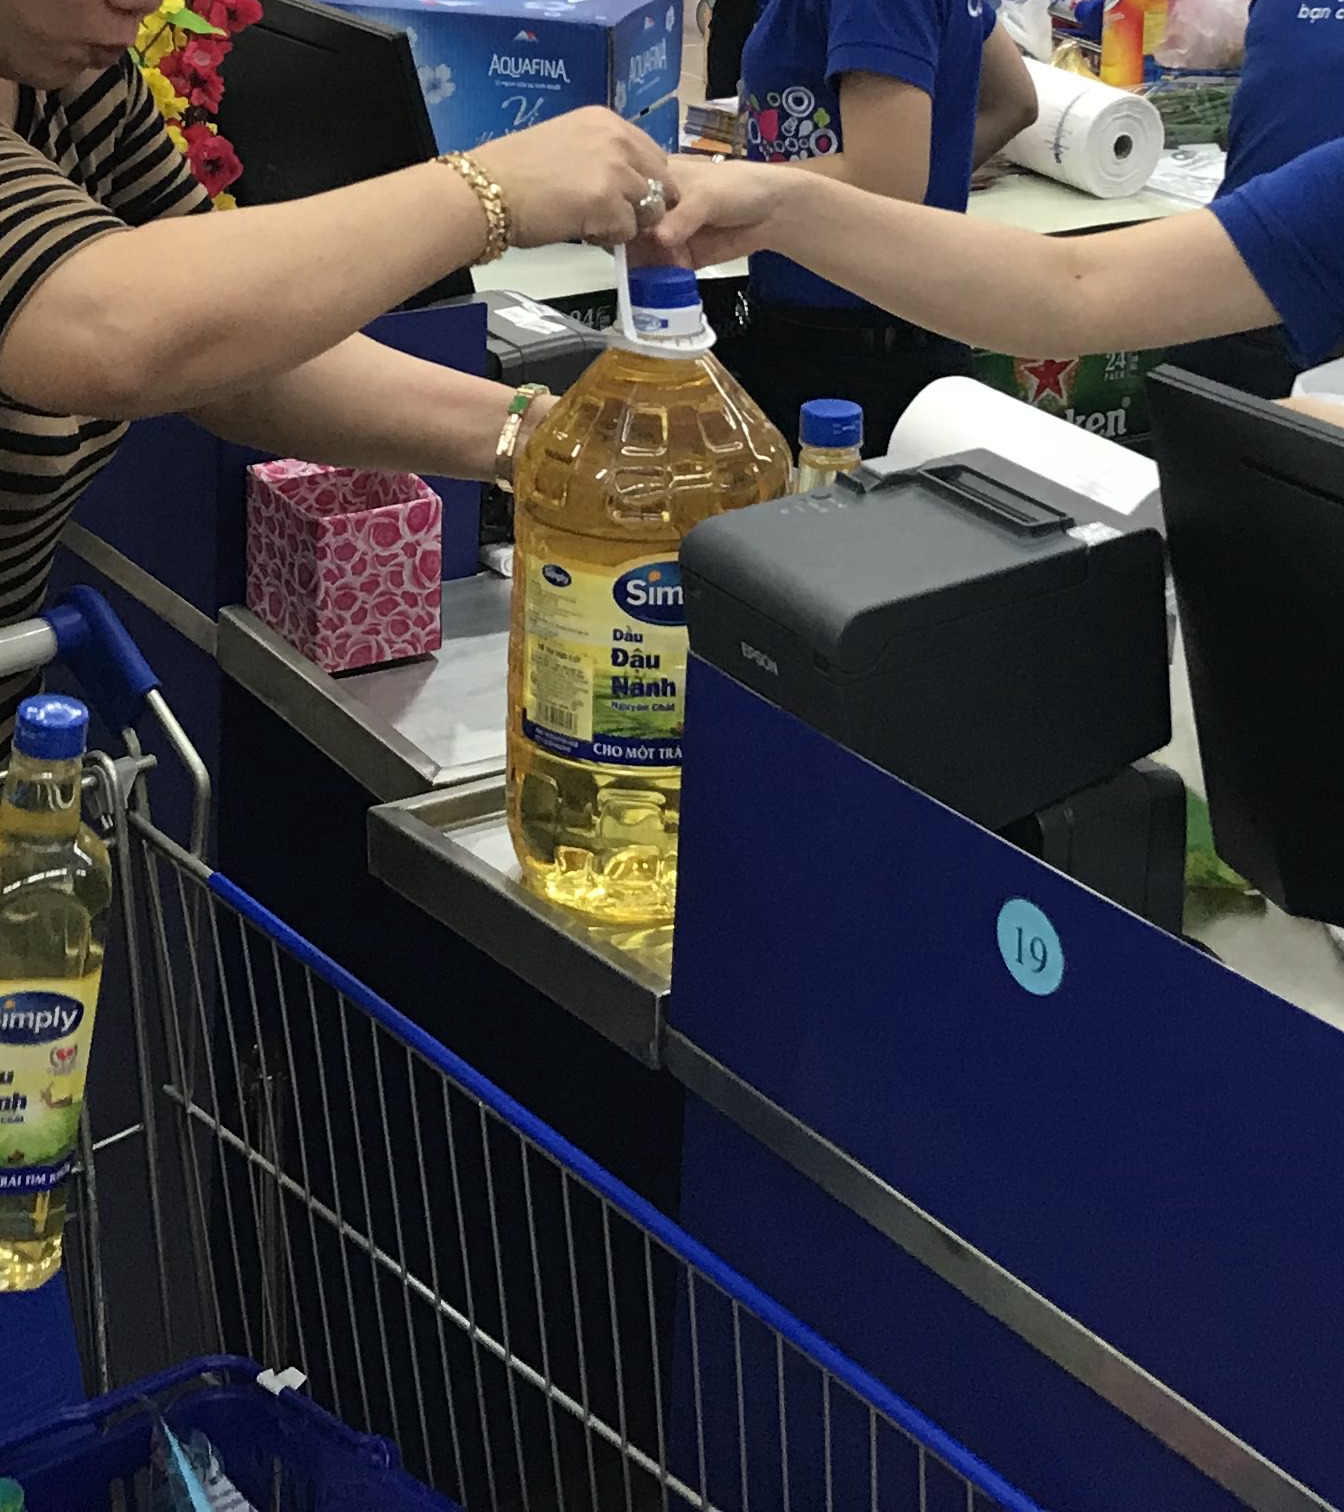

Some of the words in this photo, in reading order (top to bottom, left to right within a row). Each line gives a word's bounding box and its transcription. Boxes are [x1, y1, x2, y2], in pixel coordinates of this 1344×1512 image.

[1297, 4, 1331, 24] bạn
[488, 53, 570, 83] AQUAFINA
[628, 38, 668, 90] AQUAFINA
[626, 576, 684, 606] Sim
[613, 625, 643, 642] Dầu
[611, 648, 660, 674] Đậu
[740, 640, 778, 676] EPSON
[611, 672, 676, 698] Nành
[593, 743, 623, 757] CHO
[626, 744, 655, 761] MỘT
[657, 744, 684, 760] TRÁ
[1015, 926, 1048, 974] 19
